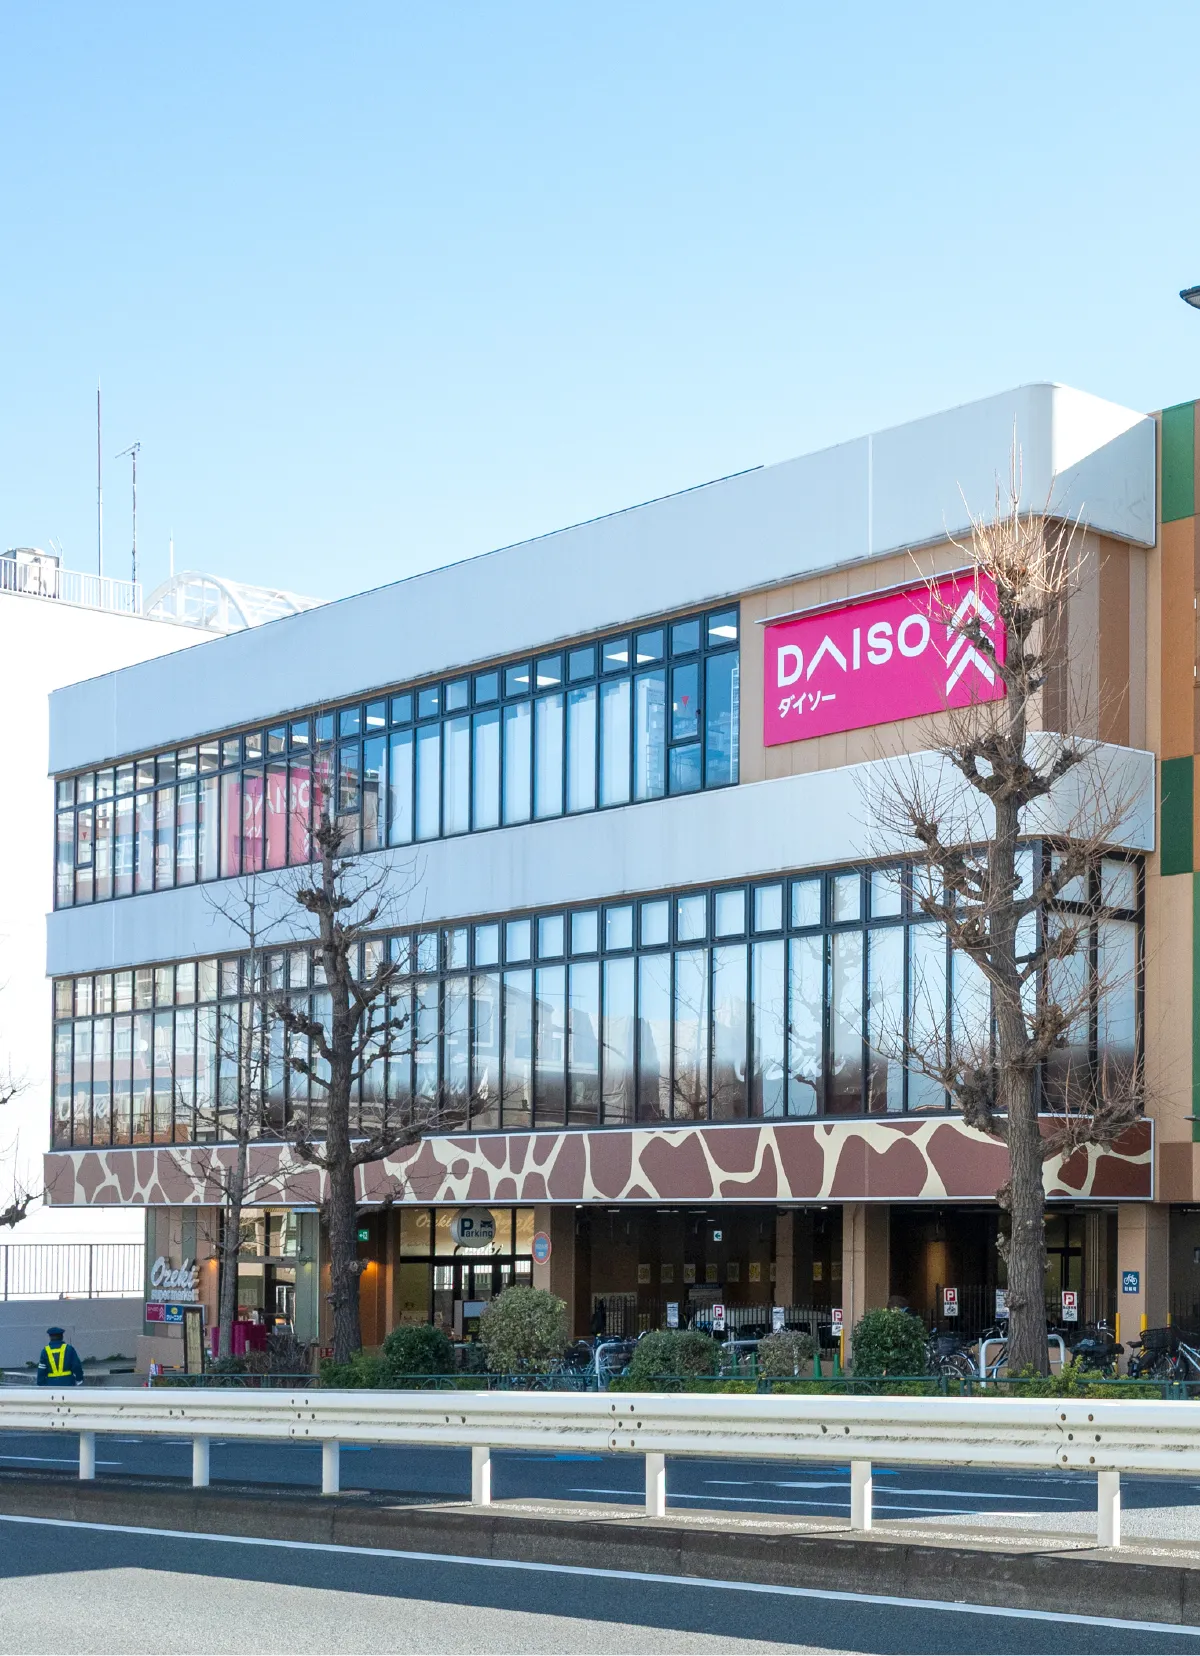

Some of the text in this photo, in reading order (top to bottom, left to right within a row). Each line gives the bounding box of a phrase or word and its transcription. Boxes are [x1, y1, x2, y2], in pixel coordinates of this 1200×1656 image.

[777, 613, 931, 688] DAISO
[777, 689, 837, 719] ダイソー
[460, 1218, 493, 1238] Parking
[151, 1256, 200, 1289] Ozeki
